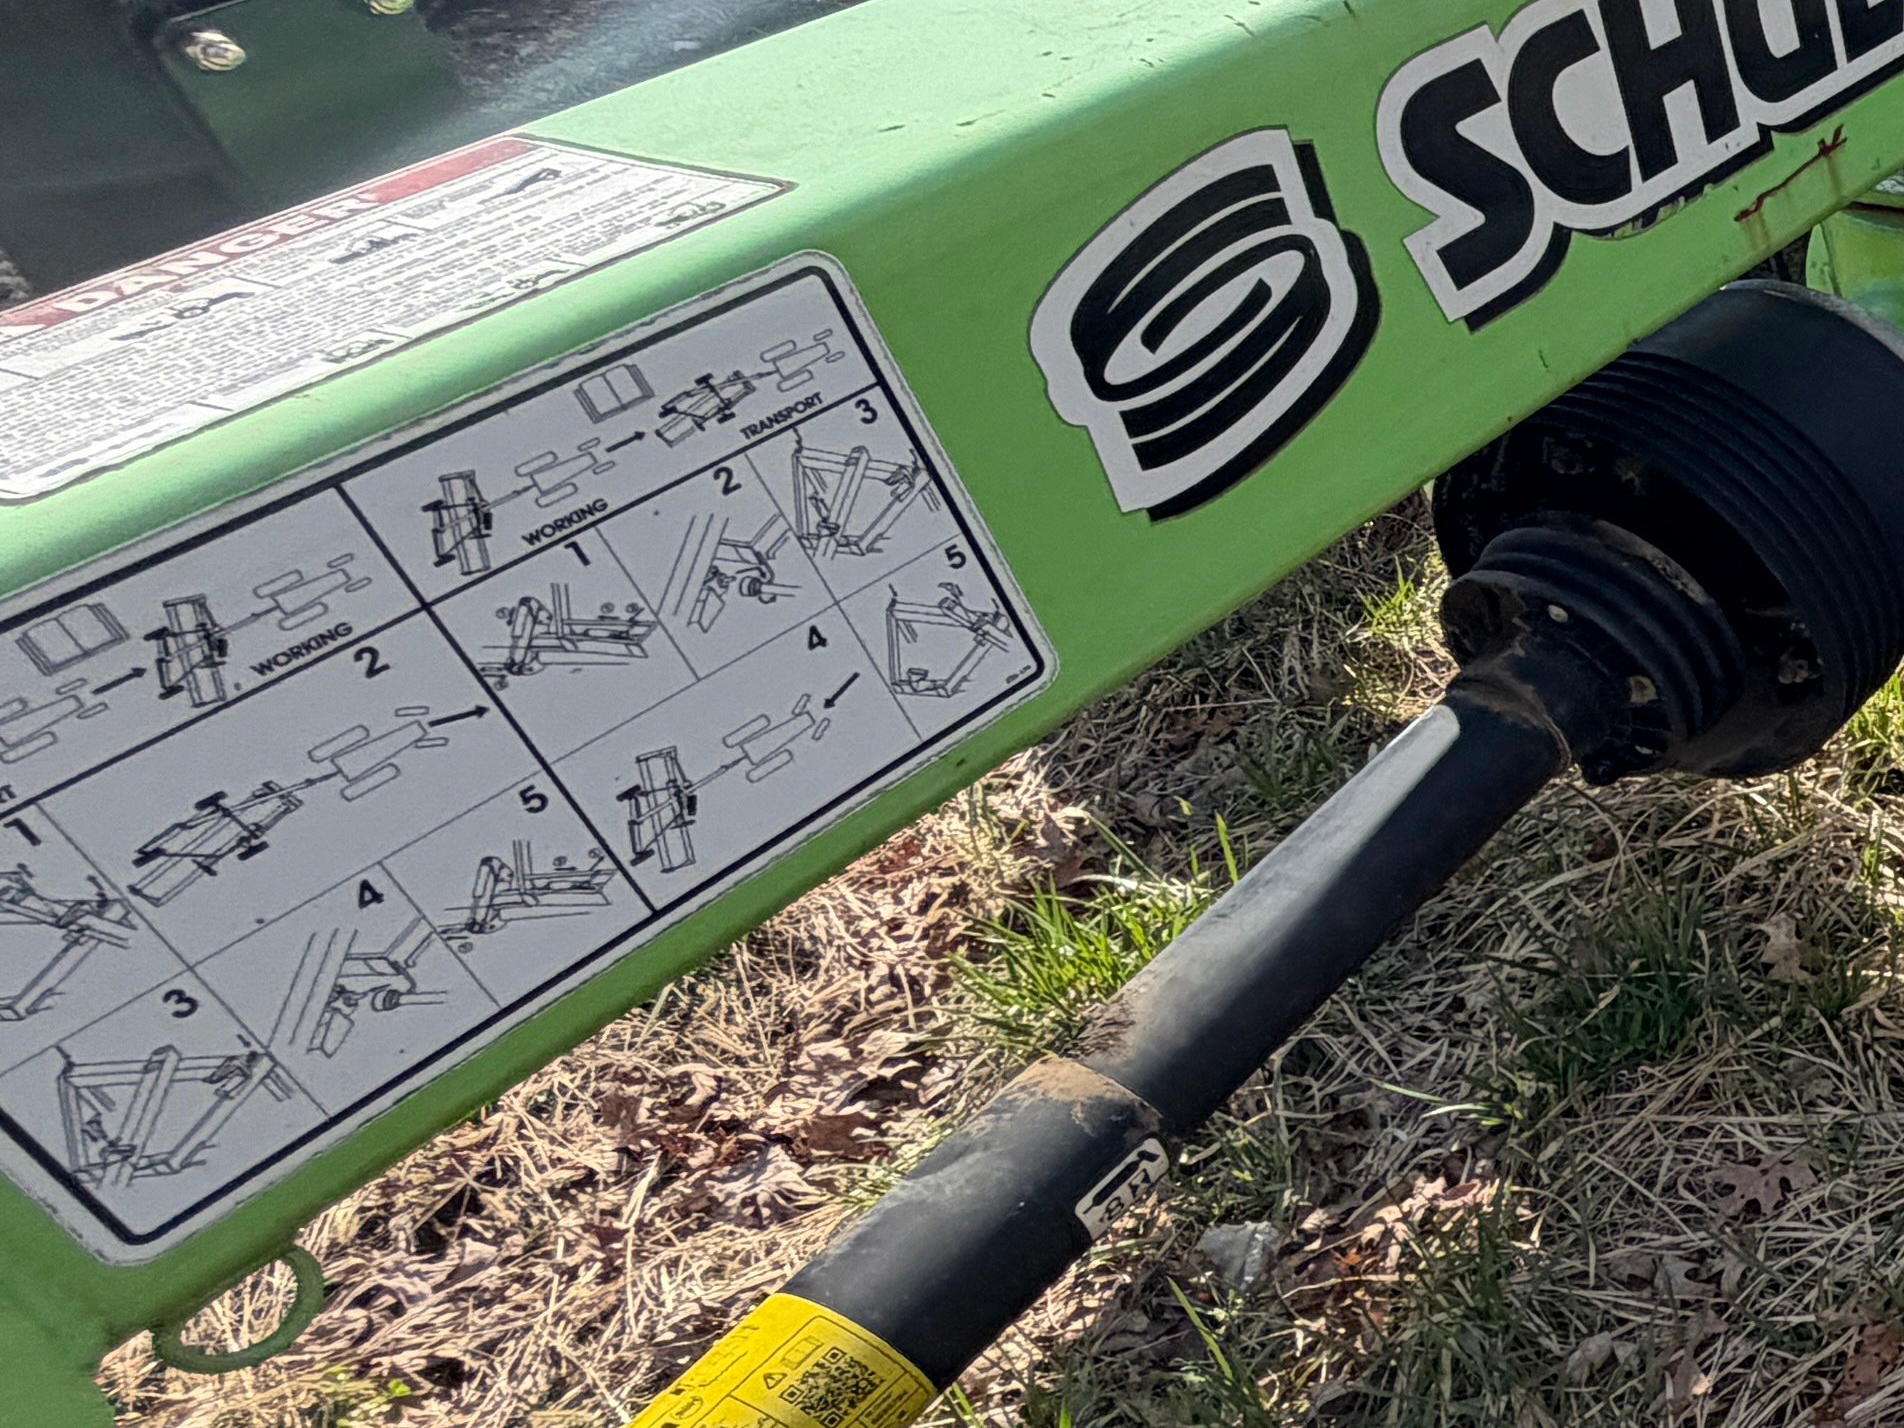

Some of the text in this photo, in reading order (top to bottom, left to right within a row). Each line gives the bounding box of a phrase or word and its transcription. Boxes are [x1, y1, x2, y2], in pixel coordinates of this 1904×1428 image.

[54, 193, 376, 313] DANGER
[522, 392, 824, 546] WORKING TRANSPORT
[564, 399, 878, 566] 1 2 3
[250, 623, 353, 676] WORKING
[808, 544, 966, 650] 4 5
[3, 647, 390, 846] 1 2
[162, 785, 549, 1018] 3 4 5
